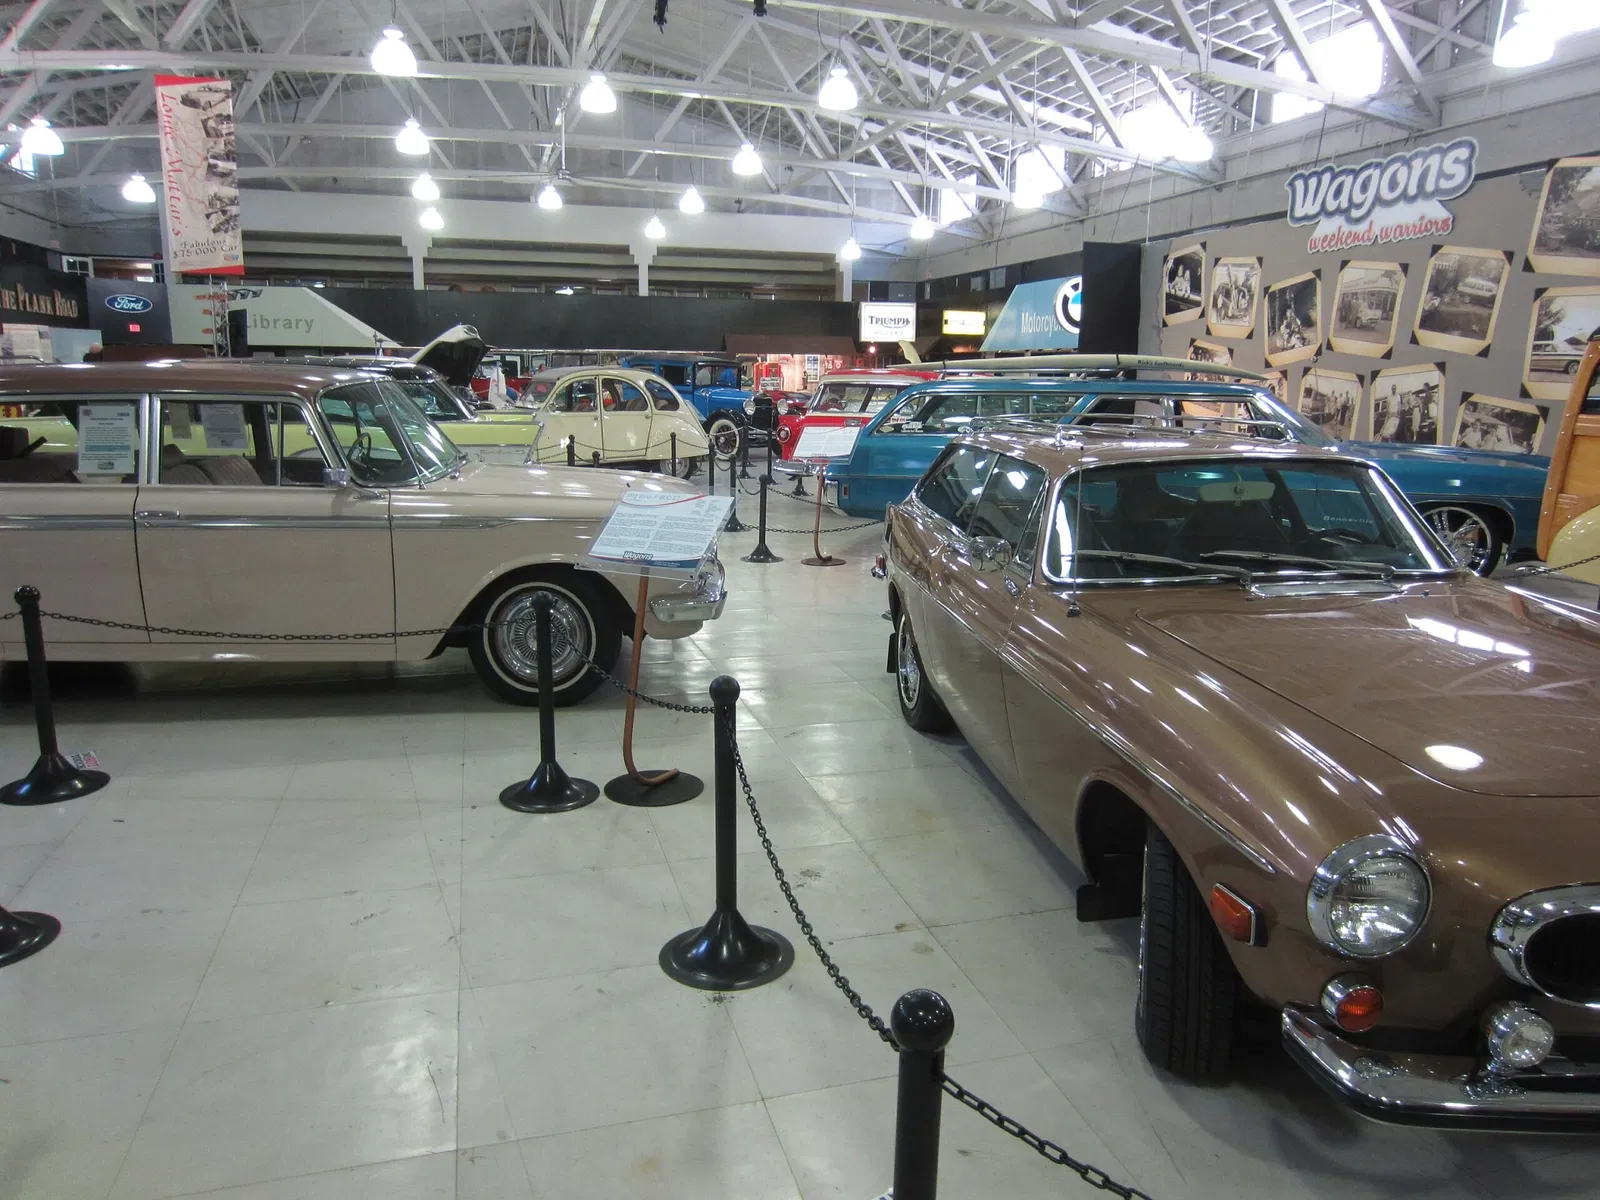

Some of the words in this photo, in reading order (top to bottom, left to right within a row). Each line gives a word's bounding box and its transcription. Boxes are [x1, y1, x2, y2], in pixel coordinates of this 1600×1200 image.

[1294, 148, 1473, 218] Wagons
[1309, 220, 1374, 251] weekend
[1379, 215, 1452, 242] warriors
[0, 288, 17, 310] HE
[115, 296, 144, 310] Ford
[247, 314, 315, 333] ibrary
[868, 315, 910, 326] TRIUMPH
